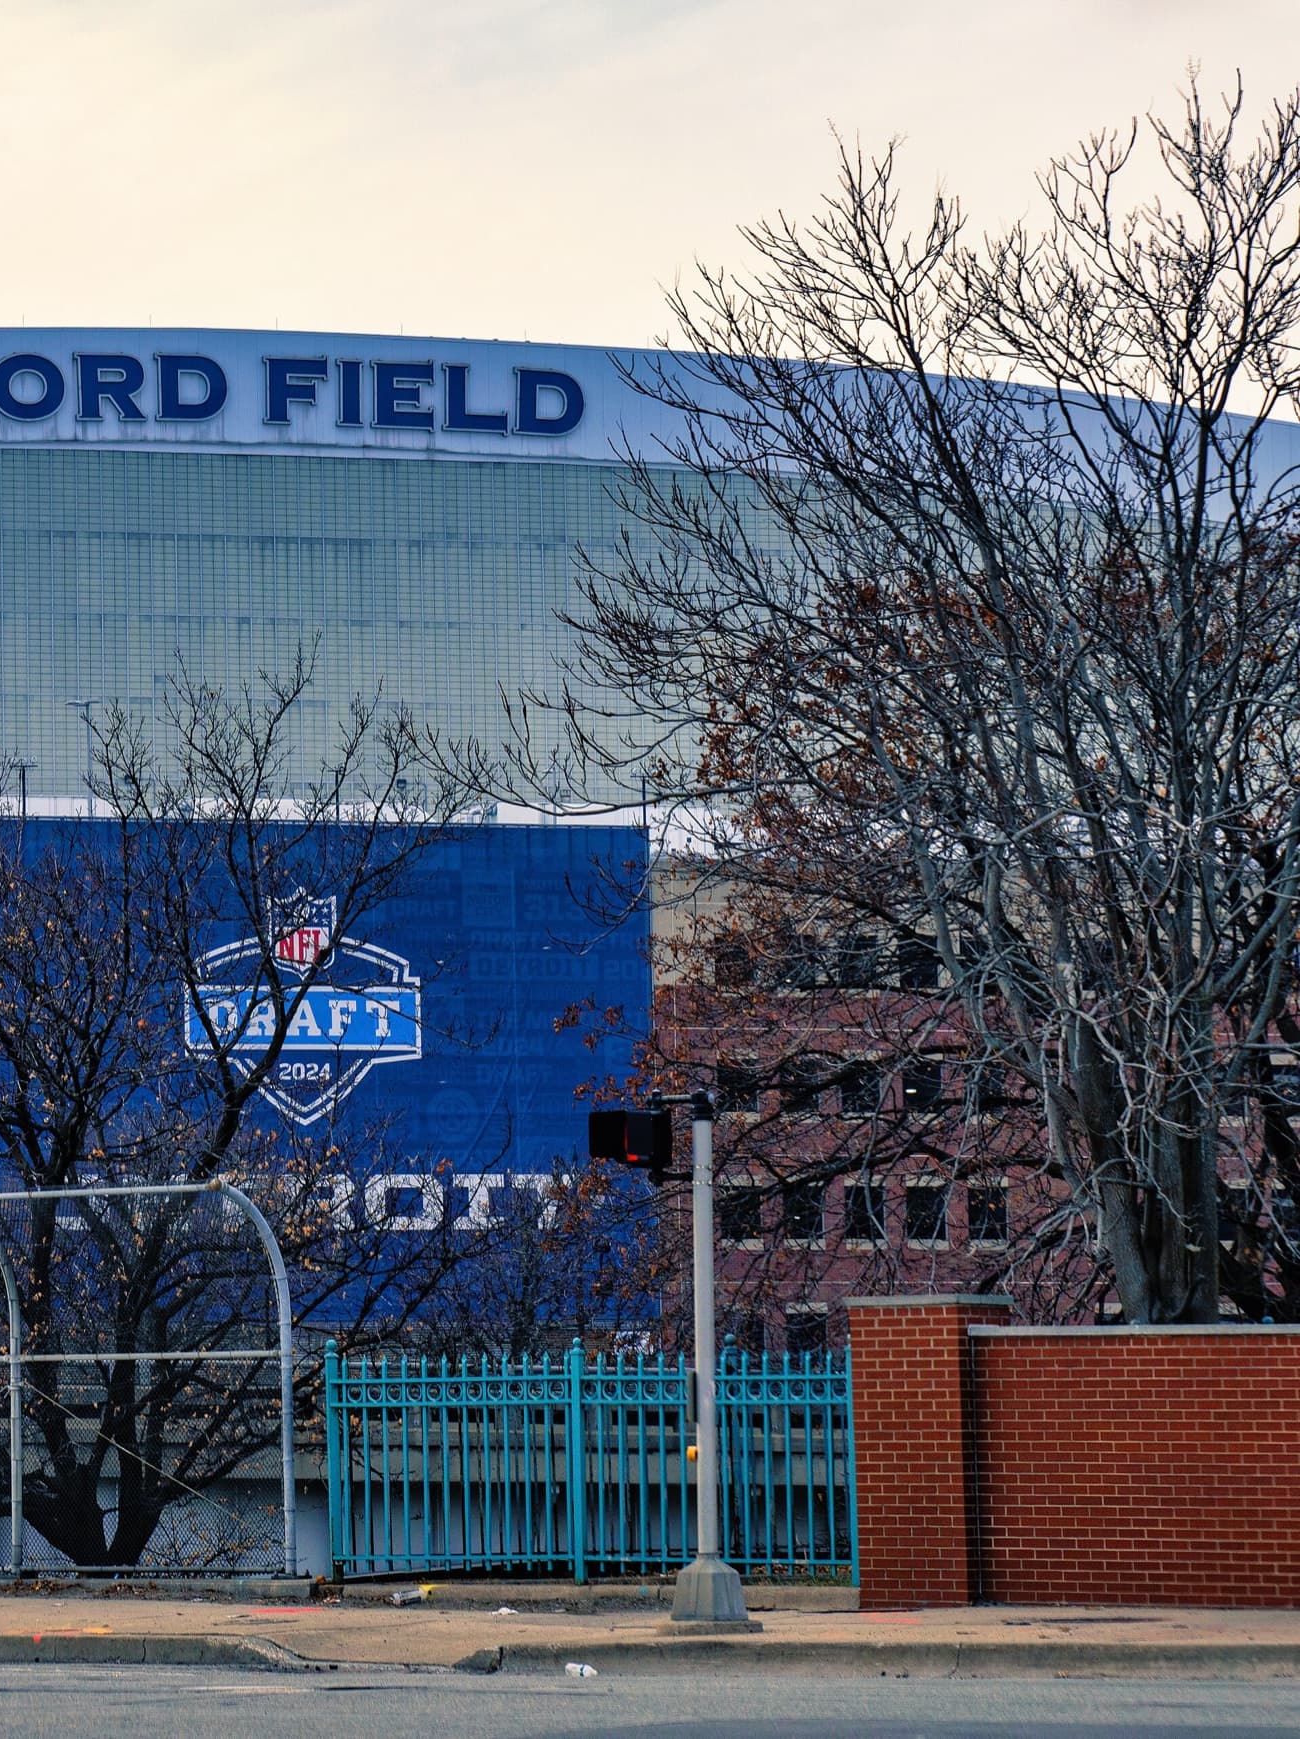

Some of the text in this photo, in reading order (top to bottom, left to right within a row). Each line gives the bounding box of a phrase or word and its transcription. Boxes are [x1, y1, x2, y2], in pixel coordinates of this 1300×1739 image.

[263, 355, 586, 437] FIELD
[207, 1000, 400, 1037] DRAFT
[279, 1063, 331, 1081] 2024
